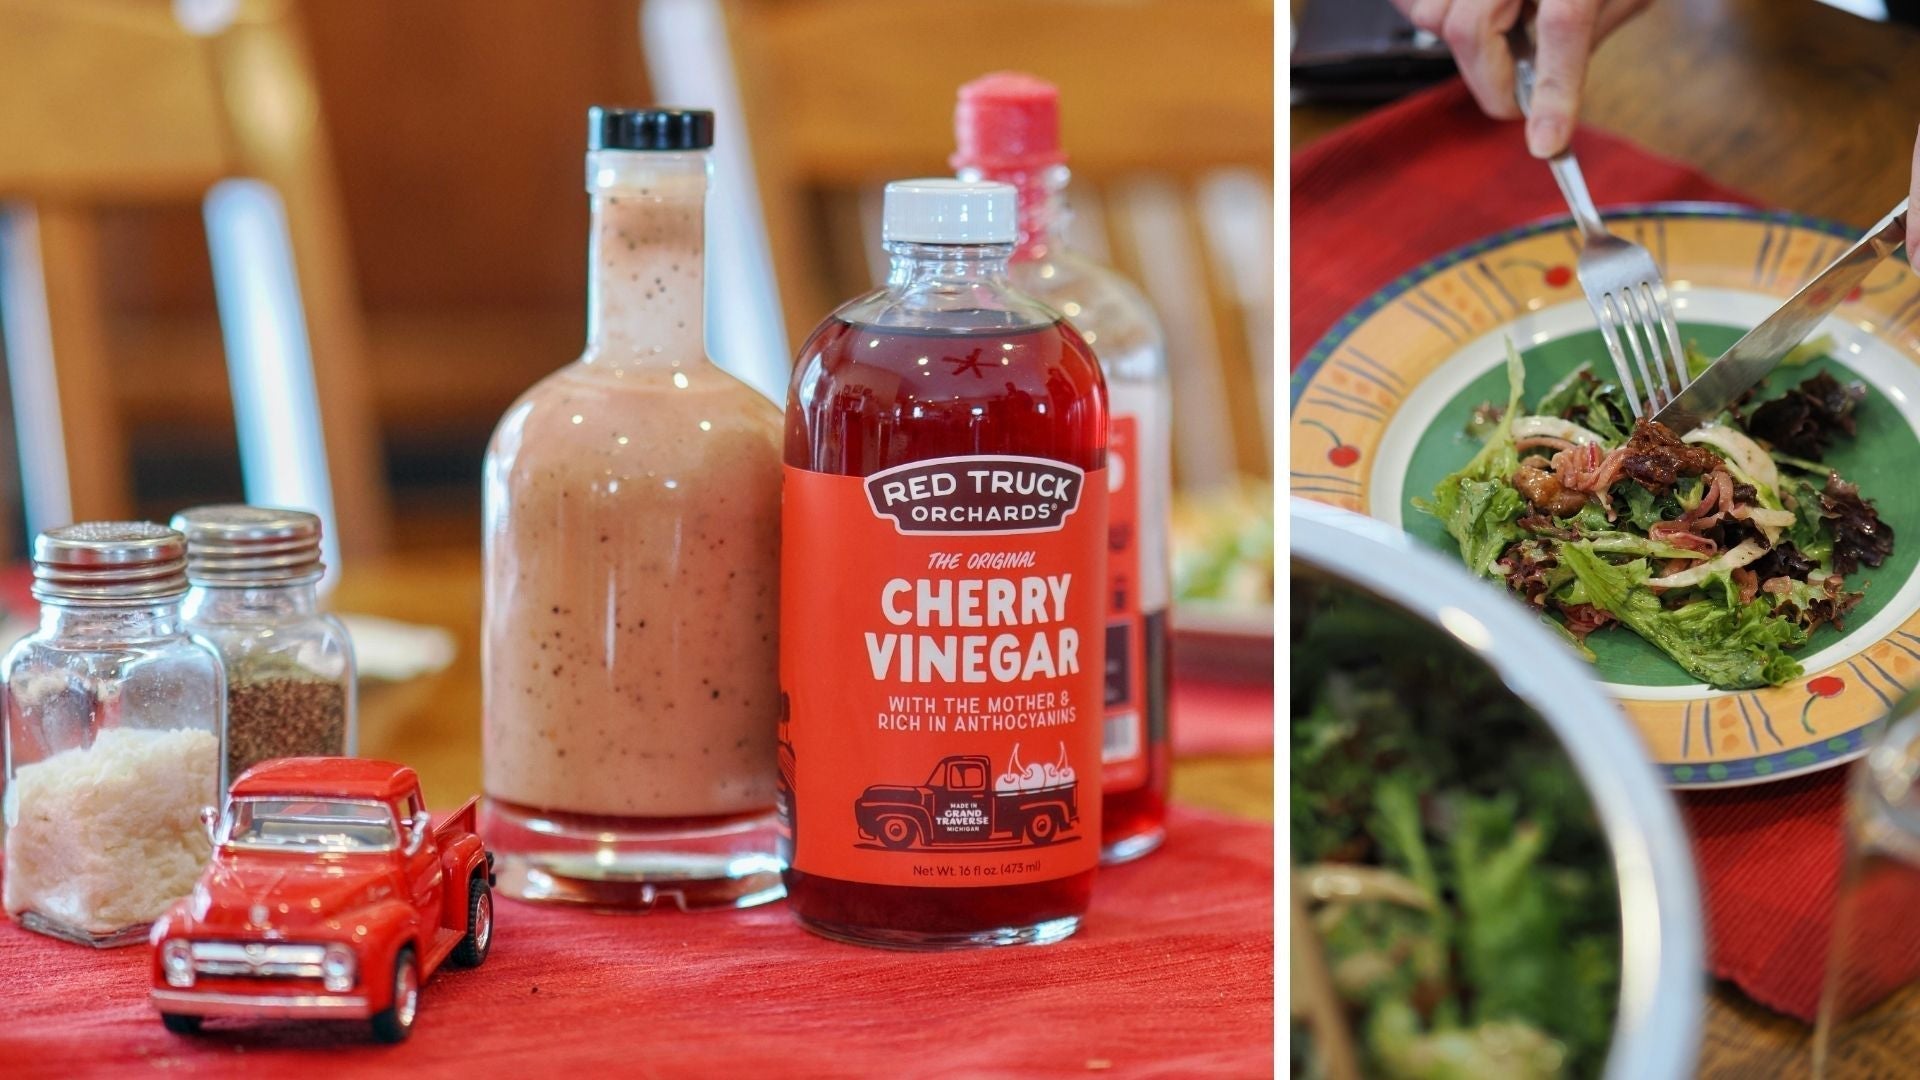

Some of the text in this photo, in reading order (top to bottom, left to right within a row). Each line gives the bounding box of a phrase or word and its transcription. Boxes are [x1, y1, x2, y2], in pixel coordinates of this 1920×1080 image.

[883, 473, 957, 506] RED
[967, 470, 1072, 501] TRUCK
[927, 551, 1036, 570] THE ORIGINAL
[881, 573, 1072, 627] CHERRY
[864, 627, 1080, 683] VINEGAR
[889, 690, 1070, 714] WITH THE MOTHER &
[878, 706, 1076, 732] RICH IN ANTHOCYANINS
[935, 816, 989, 825] TRAVERSE
[944, 809, 982, 818] GRAND
[913, 865, 934, 876] Net
[960, 865, 971, 876] 16
[973, 865, 981, 876] fl
[1000, 861, 1024, 875] (473
